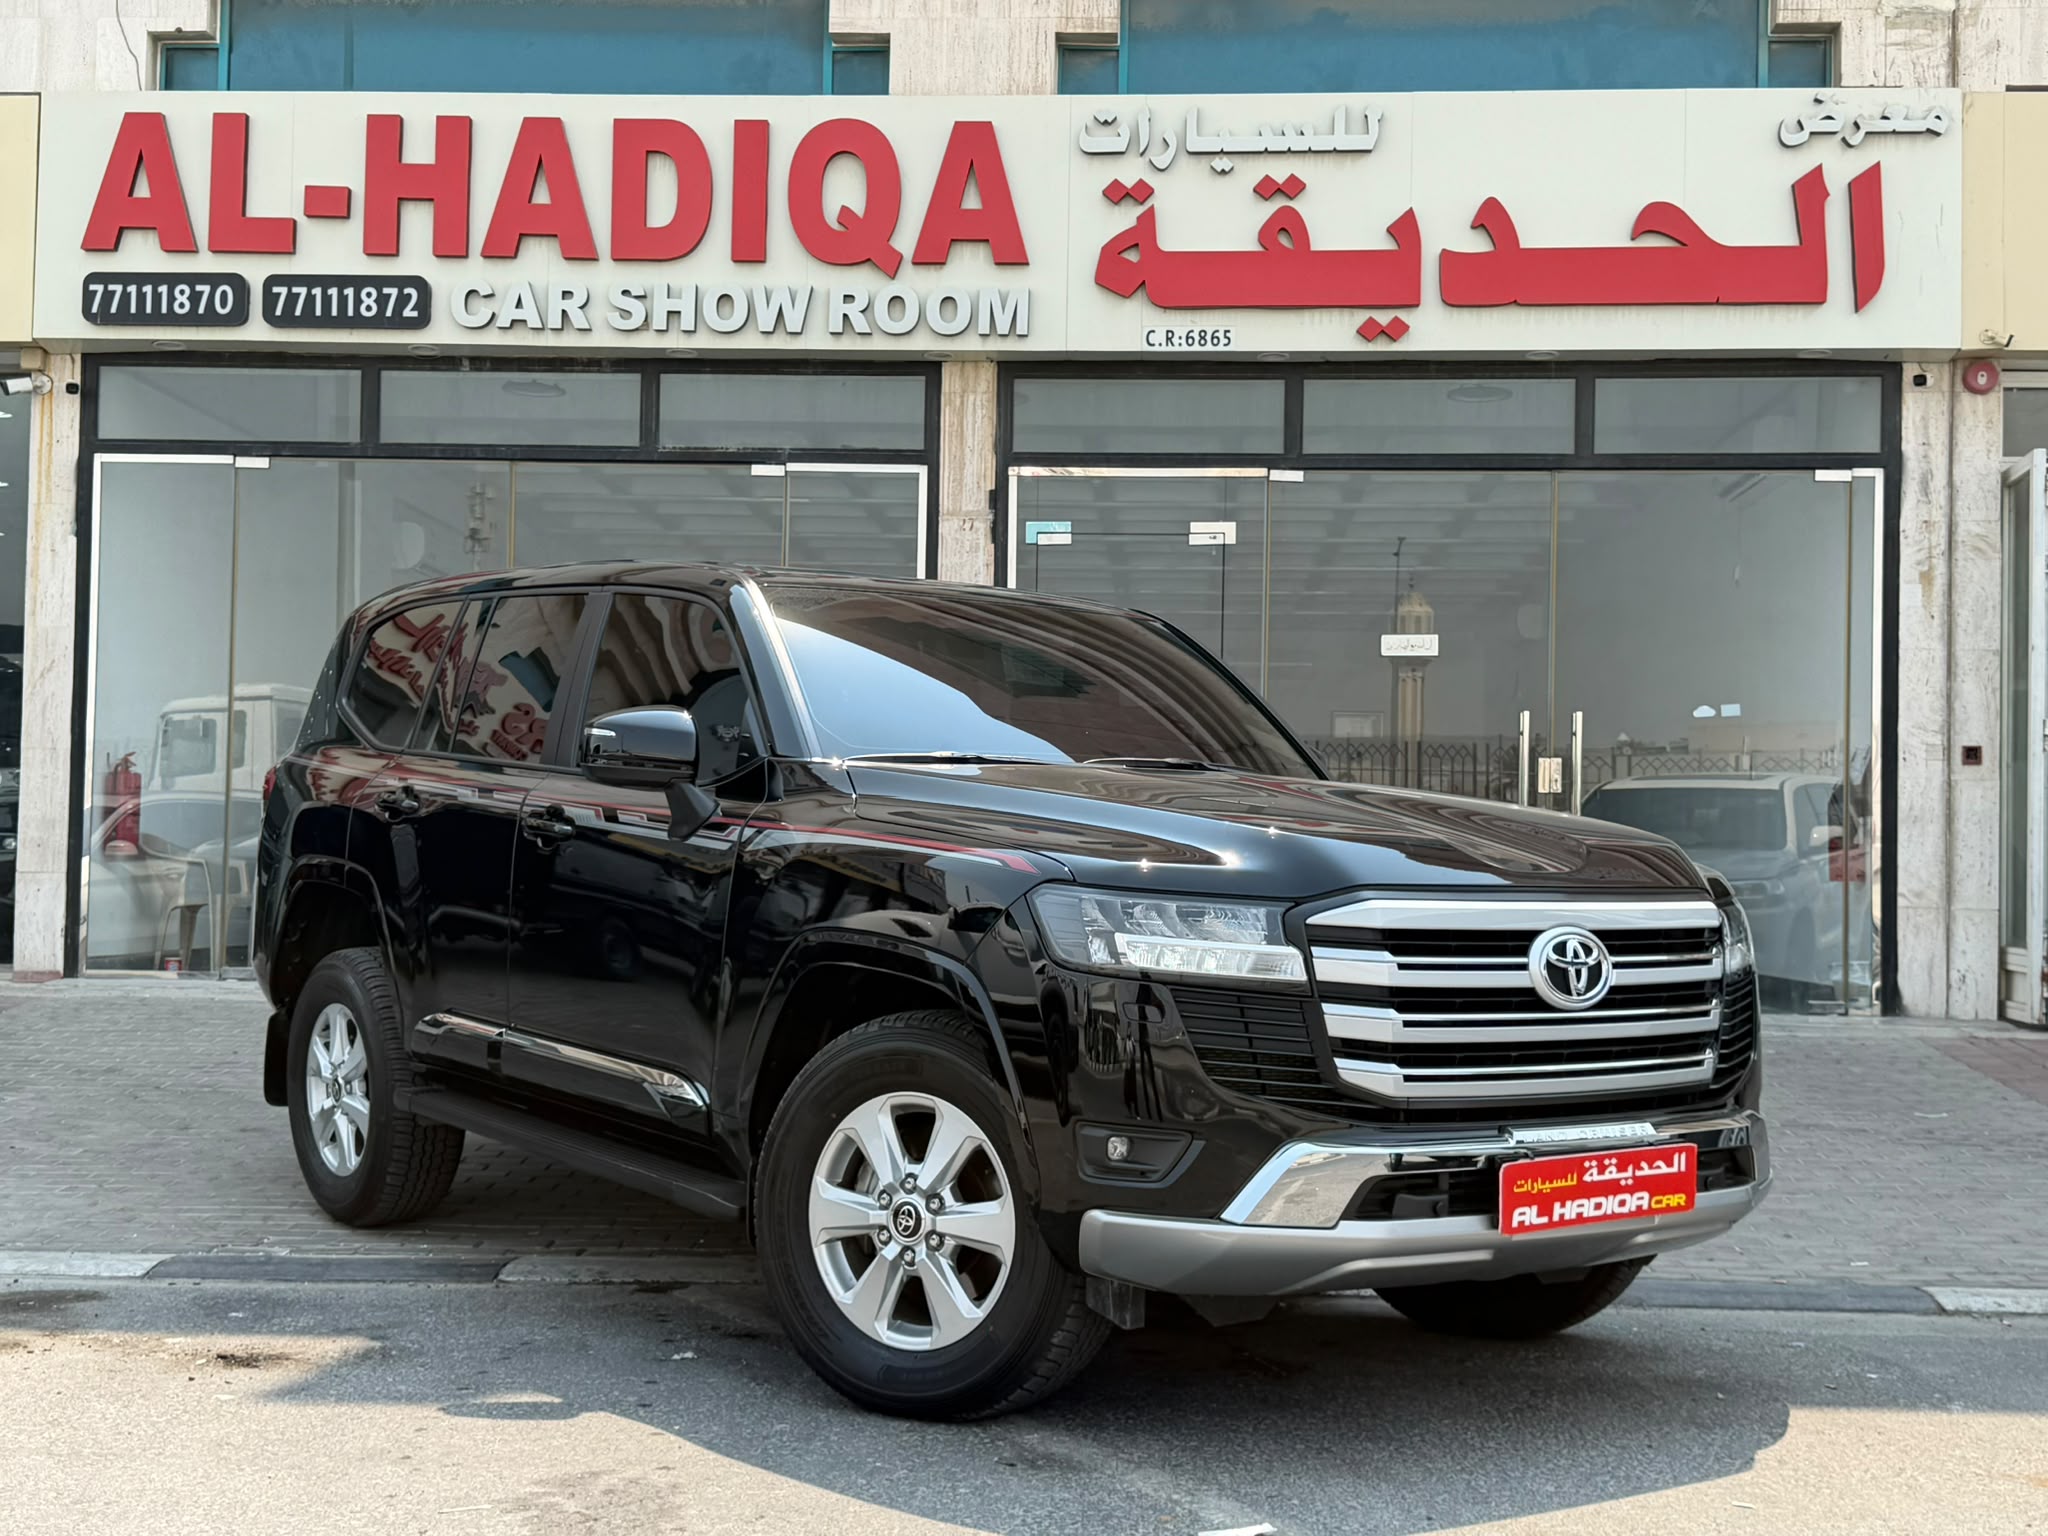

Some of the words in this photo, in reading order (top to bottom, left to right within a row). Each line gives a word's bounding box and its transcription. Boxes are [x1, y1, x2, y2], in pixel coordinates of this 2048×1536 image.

[1778, 92, 1950, 148] معرض
[1079, 104, 1383, 174] للسيارات
[81, 112, 1029, 279] AL-HADIQA
[1095, 161, 1885, 342] الحديقة
[88, 283, 234, 315] 77111870
[271, 286, 419, 317] 77111872
[450, 279, 592, 332] CAR
[606, 283, 813, 333] SHOW
[829, 286, 1030, 337] ROOM
[1145, 328, 1233, 348] C.R:6865
[1513, 1168, 1577, 1194] للسيارات
[1582, 1152, 1687, 1186] الحديقة
[1512, 1205, 1549, 1228] AL
[1552, 1191, 1650, 1222] HADIQA
[1651, 1193, 1687, 1209] CAR
